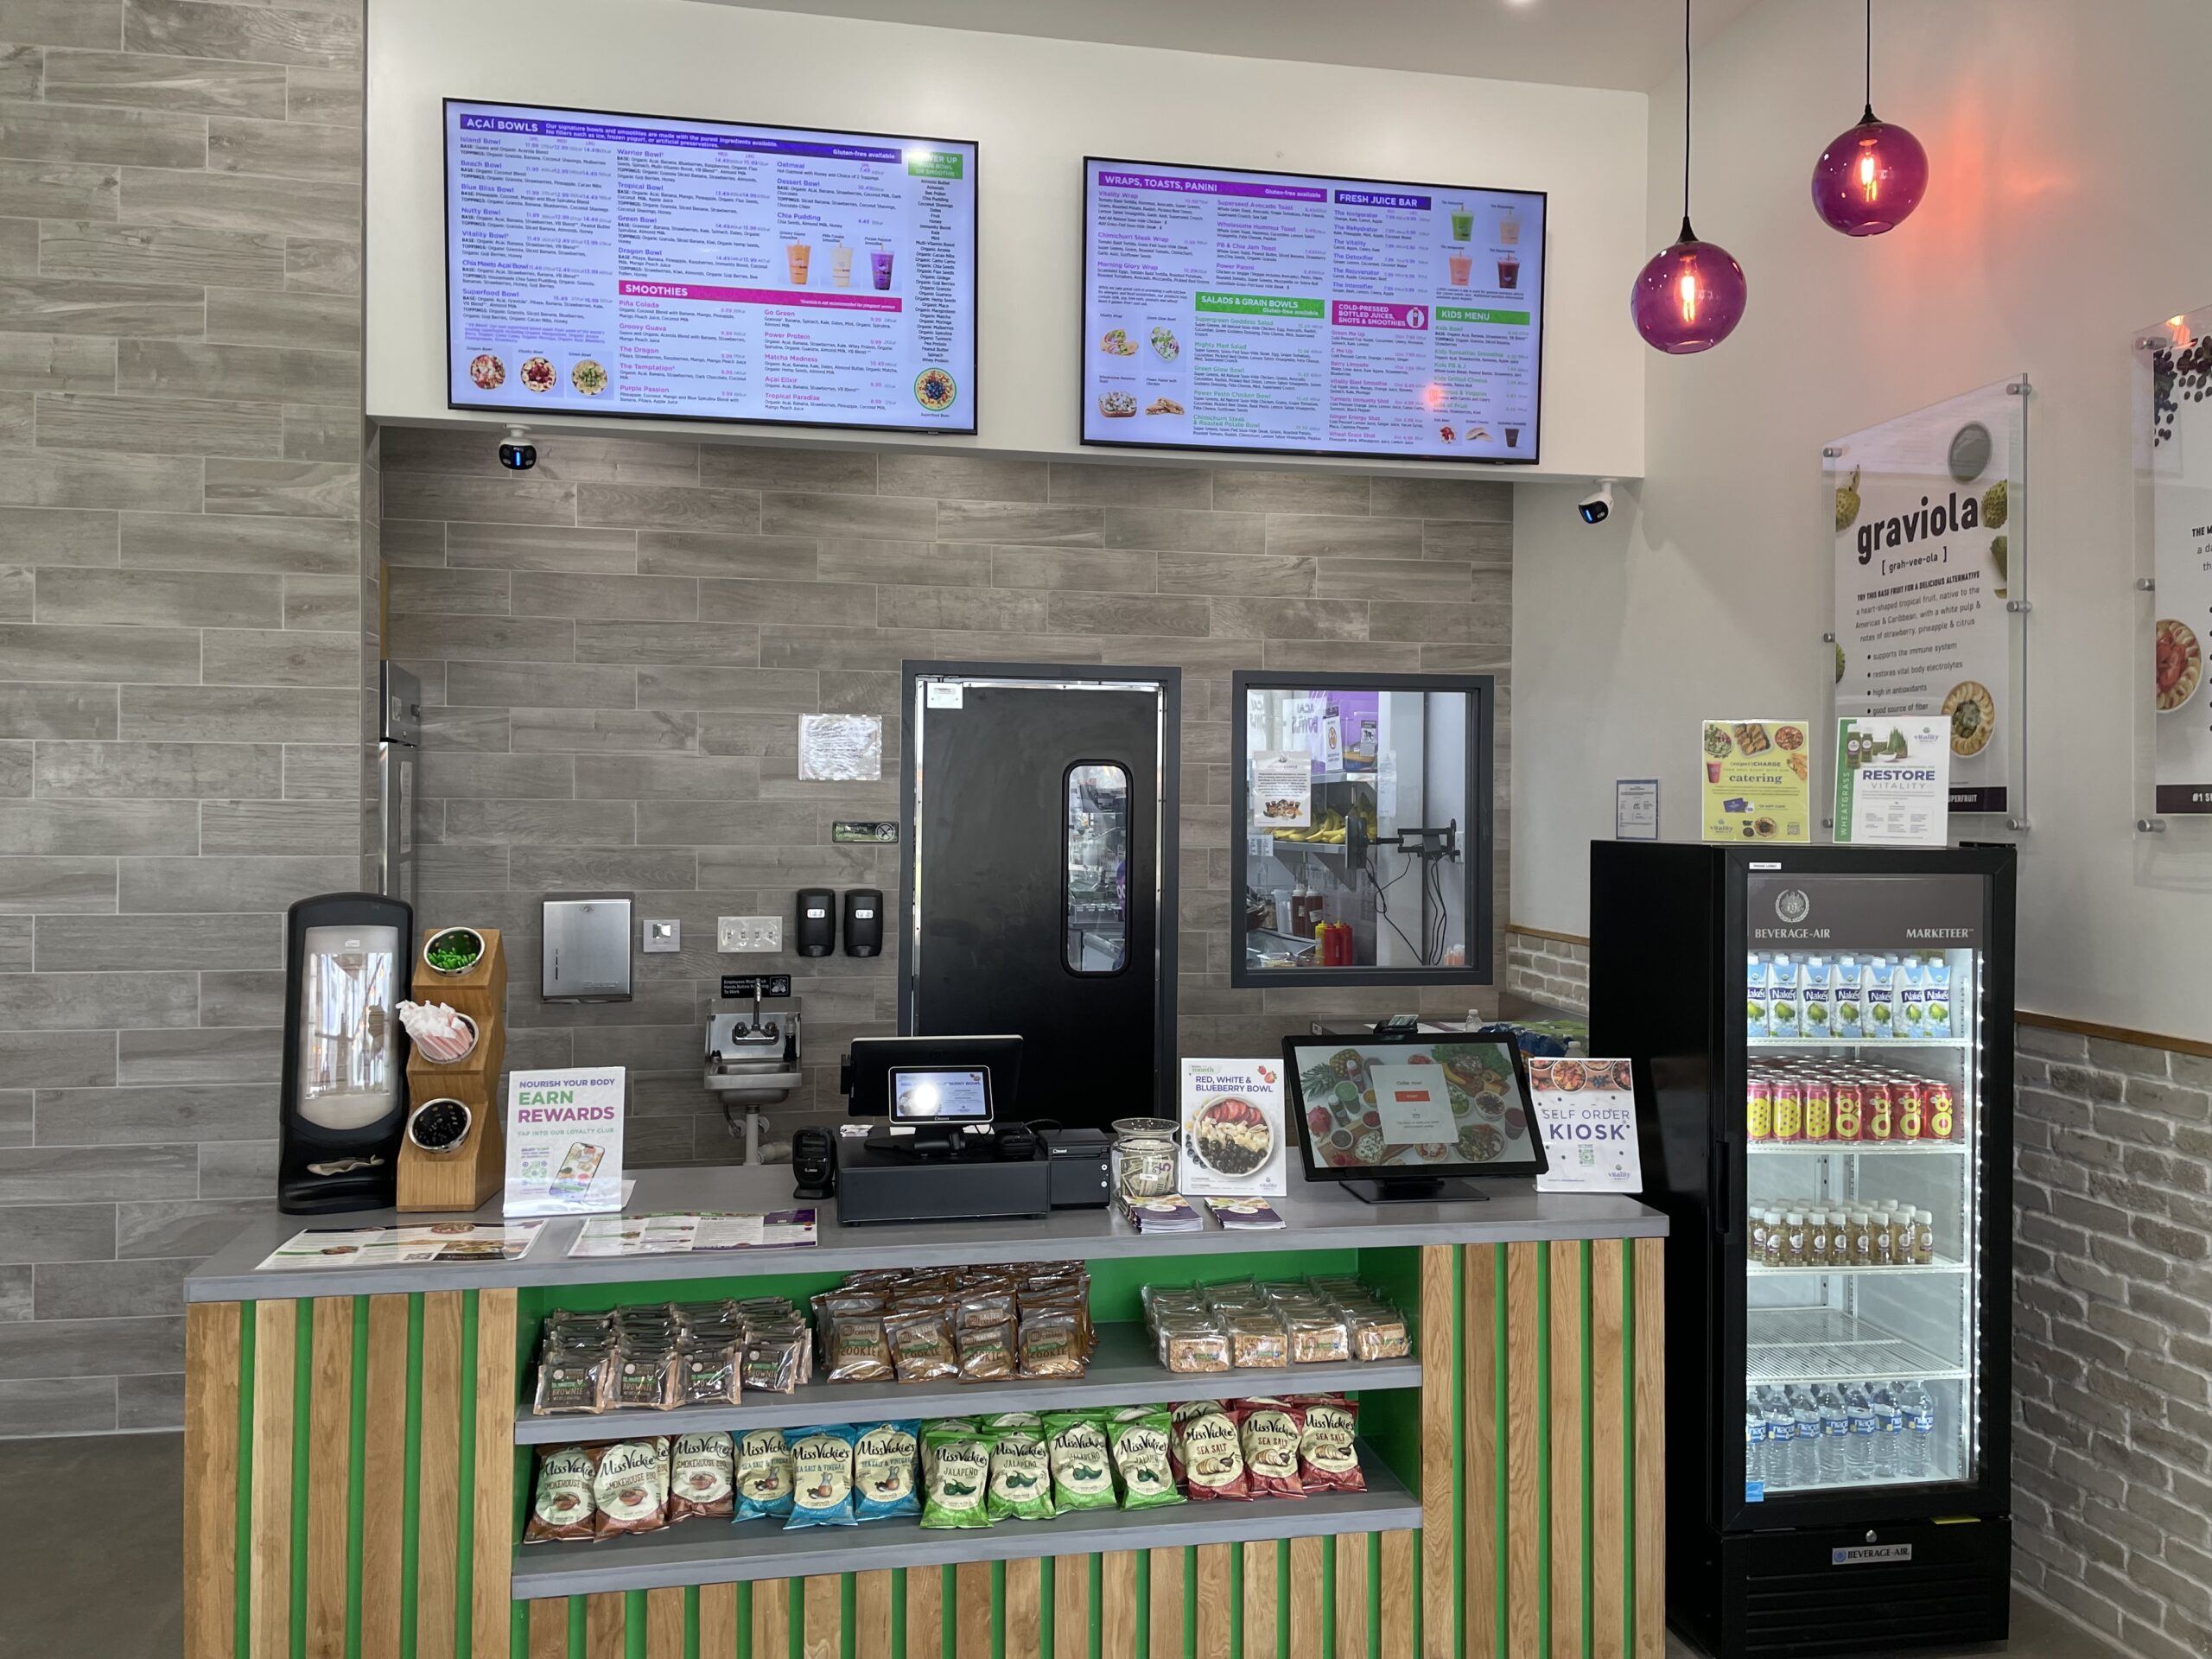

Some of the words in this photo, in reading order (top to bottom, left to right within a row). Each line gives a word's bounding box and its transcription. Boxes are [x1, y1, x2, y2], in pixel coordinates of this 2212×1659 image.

[467, 118, 494, 130] AÇAÍ
[498, 121, 538, 131] BOWLS
[833, 149, 867, 158] Gluten-free
[1105, 175, 1141, 188] WRAPS,
[1144, 178, 1183, 190] TOASTS,
[1185, 181, 1217, 192] PANINI
[1339, 194, 1369, 203] FRESH
[1371, 196, 1396, 206] JUICE
[1399, 199, 1418, 207] BAR
[461, 207, 480, 216] Nutty
[795, 213, 821, 222] Pudding
[619, 247, 642, 256] Dragon
[463, 289, 498, 297] Superfood
[626, 284, 688, 296] SMOOTHIES
[1202, 296, 1232, 305] SALADS
[1235, 297, 1241, 306] &
[1243, 298, 1268, 308] GRAIN
[1269, 300, 1298, 308] BOWLS
[1338, 304, 1389, 313] COLD-PRESSED
[1372, 313, 1395, 321] JUICES,
[1442, 311, 1462, 320] KIDS
[1465, 312, 1490, 321] MENU
[620, 323, 643, 332] Groovy
[766, 392, 791, 401] Tropical
[1858, 493, 1978, 565] graviola
[2192, 527, 2204, 537] THE
[1889, 553, 1938, 574] grah-vee-ola
[1878, 589, 1890, 598] BASE
[1891, 586, 1904, 596] FRUIT
[1904, 583, 1914, 593] FOR
[1920, 578, 1945, 590] DELICIOUS
[1946, 571, 1980, 585] ALTERNATIVE
[1861, 601, 1897, 615] heart-shaped
[1899, 597, 1922, 609] tropical
[1923, 594, 1937, 603] fruit,
[1939, 590, 1959, 601] native
[1855, 618, 1880, 629] Americas
[1920, 609, 1934, 618] with
[1941, 604, 1958, 615] white
[1960, 602, 1974, 613] pulp
[1976, 601, 1981, 609] &
[1860, 632, 1875, 642] notes
[1918, 622, 1948, 635] pineapple
[1950, 620, 1955, 628] &
[1956, 617, 1974, 627] citrus
[1873, 650, 1897, 661] supports
[1898, 646, 1907, 656] the
[1910, 645, 1933, 655] immune
[1935, 641, 1957, 652] system
[1873, 668, 1896, 678] restores
[1897, 665, 1910, 676] vital
[1911, 663, 1924, 675] body
[1927, 660, 1962, 673] electrolytes
[1872, 688, 1885, 697] high
[1892, 683, 1927, 695] antioxidants
[1872, 706, 1885, 716] good
[1888, 704, 1906, 714] source
[1730, 773, 1782, 784] catering
[1863, 770, 1936, 780] RESTORE
[1840, 772, 1850, 836] WHEATGRASS
[1755, 928, 1830, 938] BEVERAGE-AIR
[1196, 1076, 1215, 1084] RED,
[519, 1090, 573, 1105] EARN
[518, 1107, 614, 1122] REWARDS
[1543, 1110, 1575, 1119] SELF
[1582, 1110, 1630, 1119] ORDER
[1549, 1124, 1625, 1140] KIOSK
[841, 1347, 876, 1356] COOKIE
[1030, 1350, 1067, 1358] COOKIE
[553, 1387, 583, 1395] BROWNIE
[1323, 1412, 1354, 1433] Vickie's
[857, 1440, 883, 1455] Miss
[881, 1438, 915, 1456] Vickie's
[1274, 1438, 1287, 1446] SALT
[793, 1446, 817, 1460] Miss
[814, 1442, 849, 1462] Vickie's
[994, 1442, 1015, 1457] Miss
[1014, 1444, 1046, 1459] Vickie's
[1197, 1446, 1210, 1455] SEA
[1212, 1443, 1227, 1452] SALT
[677, 1459, 715, 1468] SMOKEHOUSE
[935, 1448, 958, 1463] Miss
[957, 1448, 988, 1467] Vickie's
[1004, 1459, 1037, 1468] JALAPEÑO
[944, 1467, 978, 1477] JALAPEÑO
[606, 1473, 644, 1491] SMOKEHOUSE
[646, 1471, 657, 1481] BBQ
[1848, 1547, 1909, 1559] BEVERAGE-AIR
